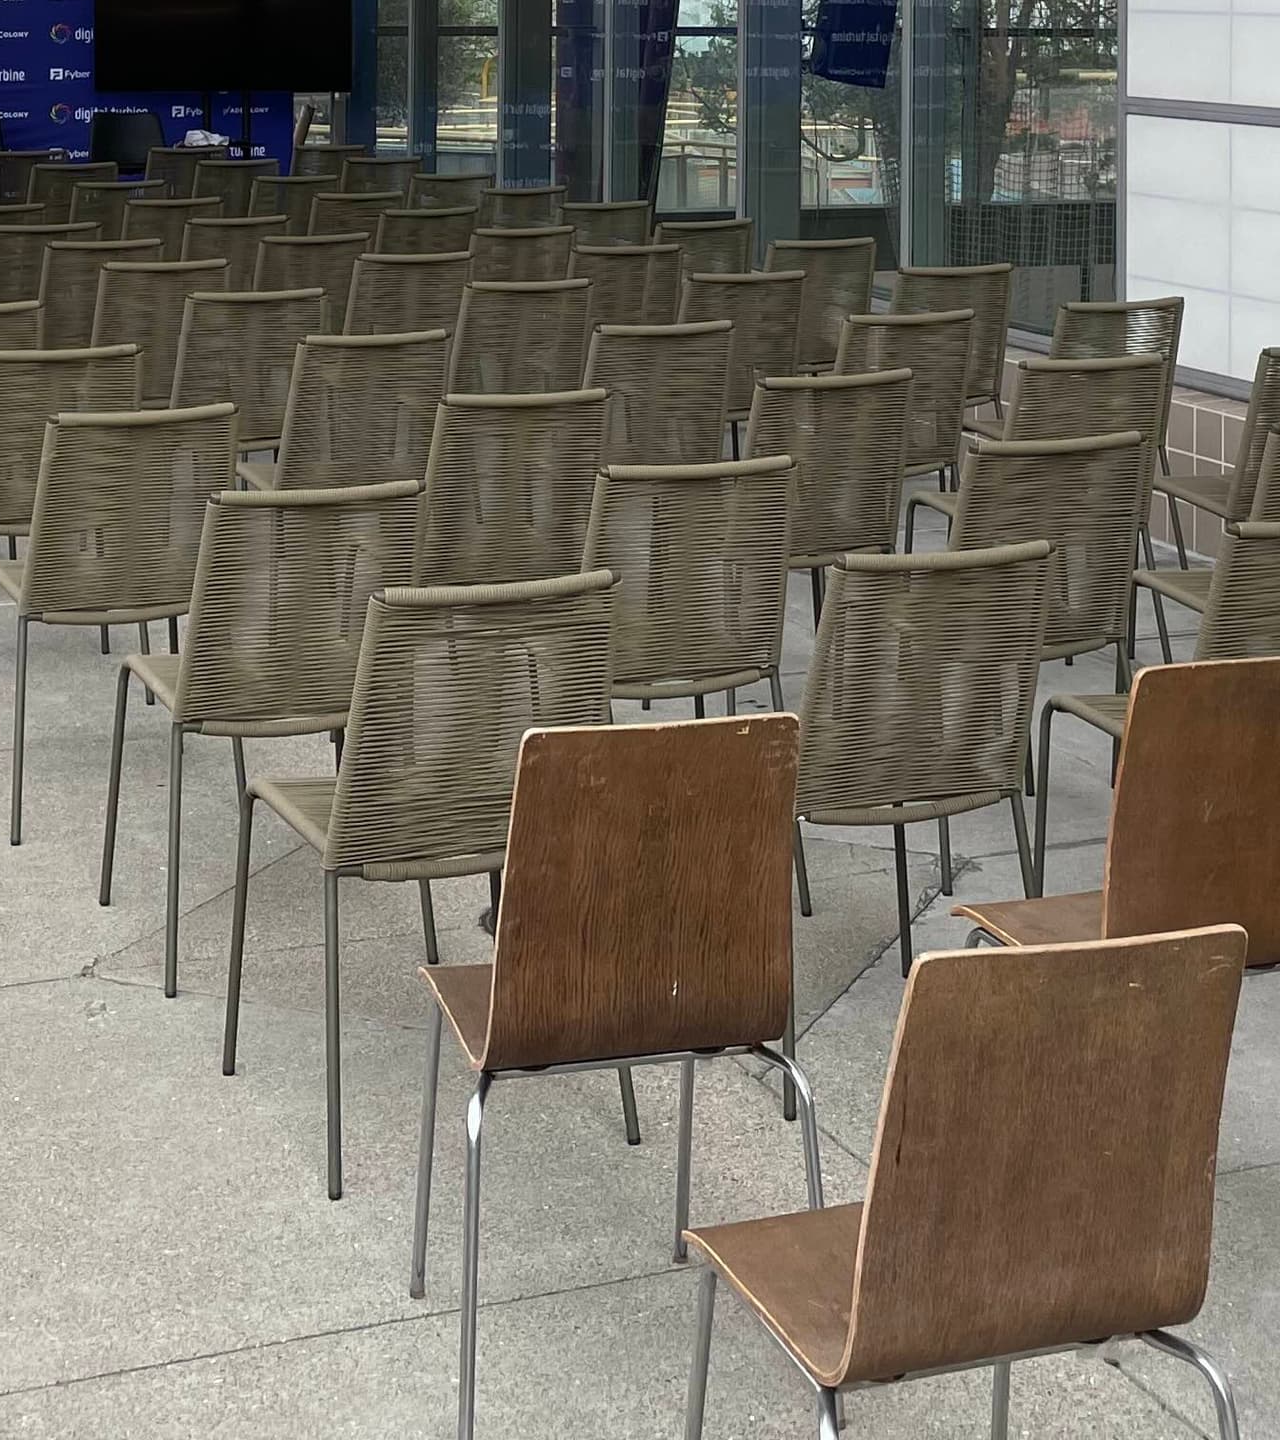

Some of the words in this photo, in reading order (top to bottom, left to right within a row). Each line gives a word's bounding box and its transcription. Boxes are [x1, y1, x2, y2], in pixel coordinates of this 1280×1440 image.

[75, 27, 94, 44] digi
[64, 69, 91, 80] Fyber
[229, 146, 266, 157] tuine
